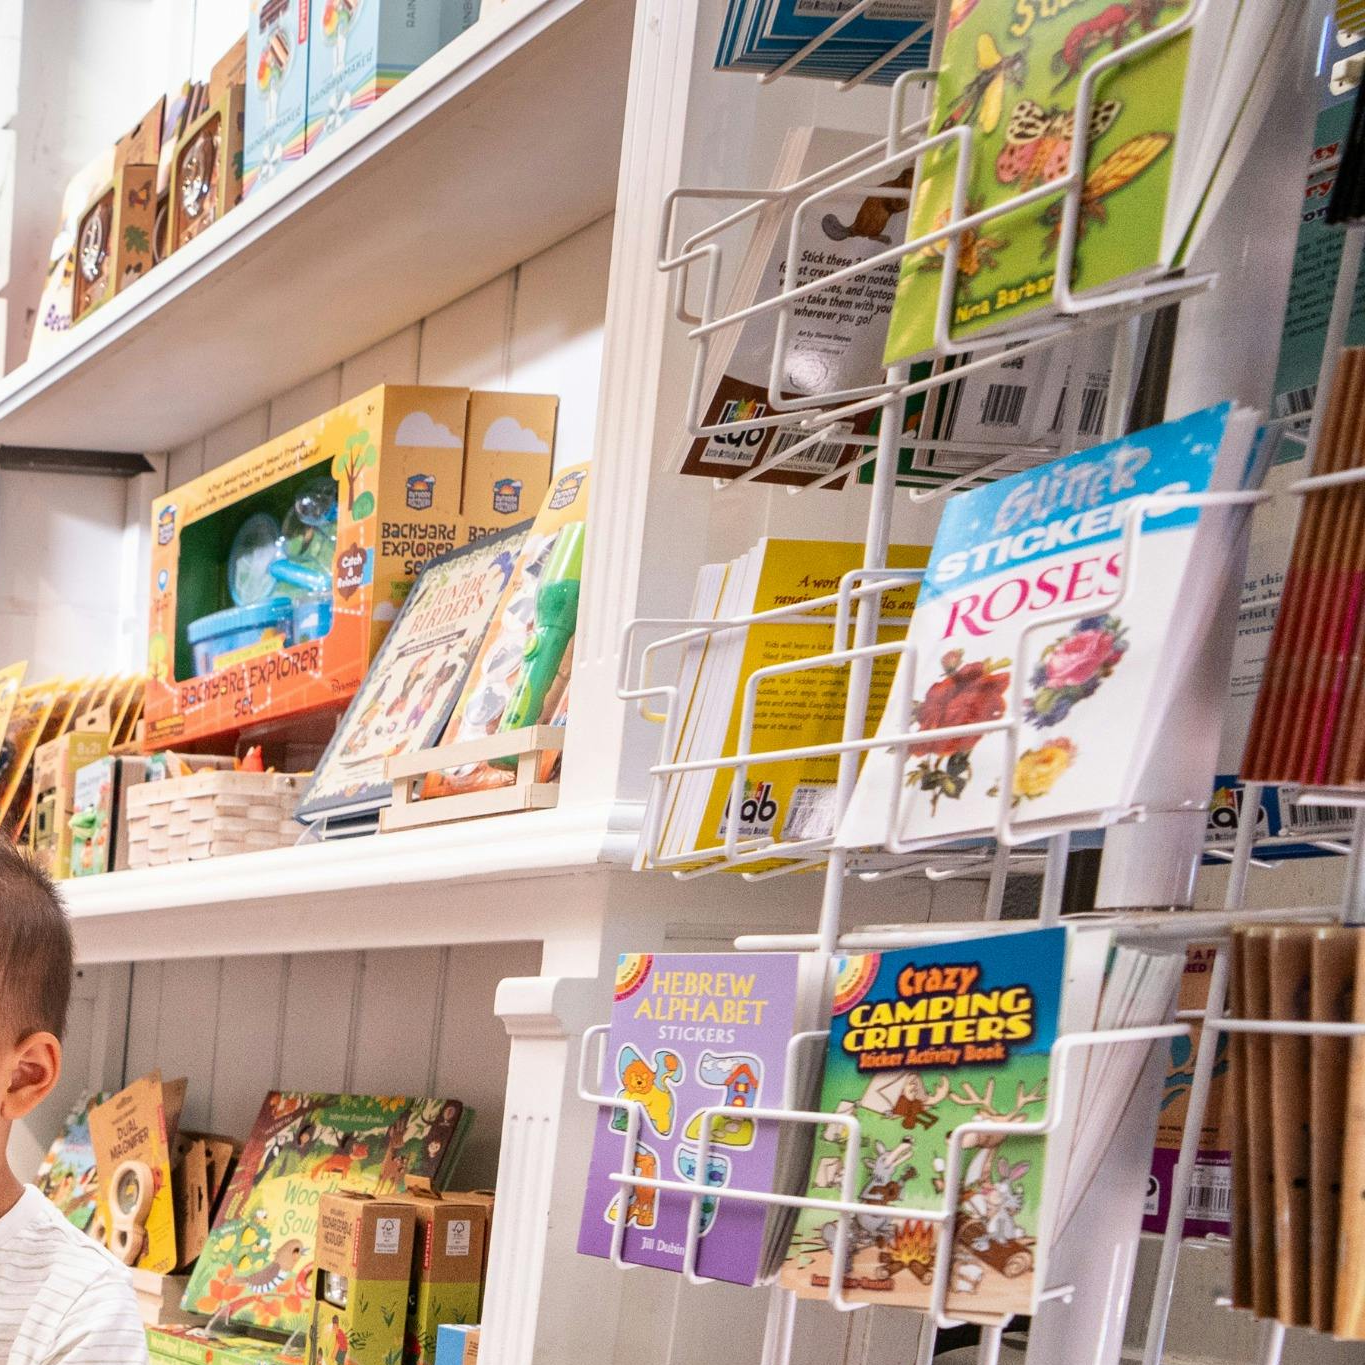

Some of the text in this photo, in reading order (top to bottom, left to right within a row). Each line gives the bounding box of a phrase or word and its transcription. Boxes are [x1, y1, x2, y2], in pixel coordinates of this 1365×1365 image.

[801, 250, 852, 267] Stick these
[807, 294, 892, 316] take them with you
[865, 286, 895, 300] laptop
[956, 275, 1056, 323] Nina Barbar
[794, 306, 874, 327] wherever you go!
[993, 444, 1154, 533] GLITTER
[935, 481, 1191, 579] STICKERS
[436, 573, 488, 604] JUNIOR
[797, 574, 841, 589] A worl
[943, 552, 1124, 641] ROSES
[653, 971, 755, 997] HEBREW
[897, 961, 980, 997] Crazy
[633, 997, 767, 1026] ALPHABET
[848, 985, 1032, 1028] CAMPING
[658, 1025, 736, 1045] STICKERS
[842, 1013, 1032, 1053] CRITTERS
[859, 1042, 1006, 1068] Sticker Activity Book
[117, 1118, 139, 1140] DUAL
[641, 1236, 685, 1257] Jill Dubin
